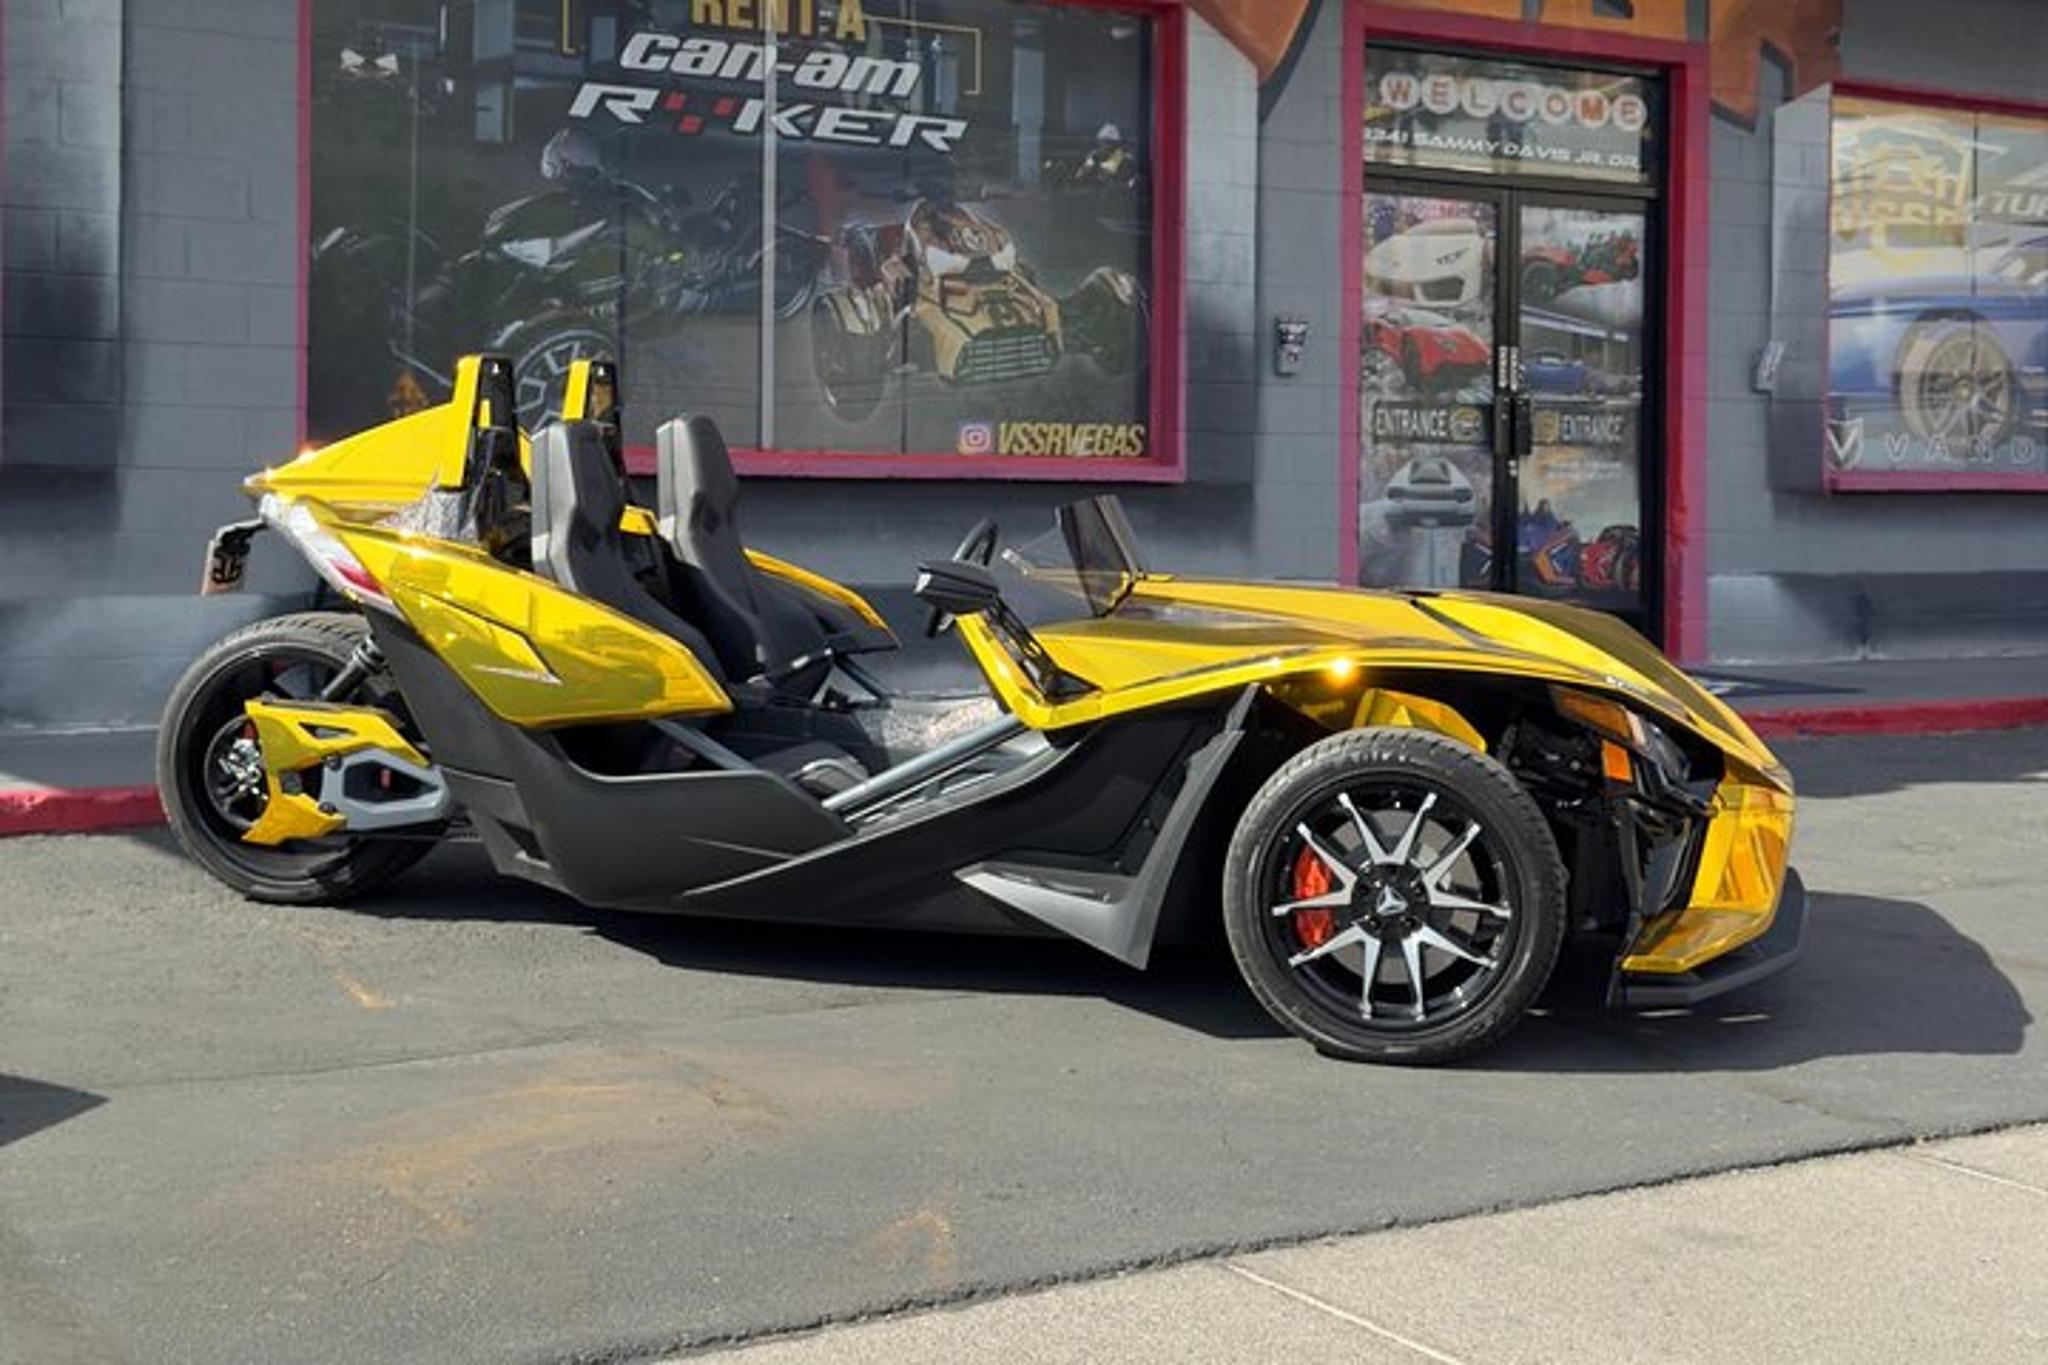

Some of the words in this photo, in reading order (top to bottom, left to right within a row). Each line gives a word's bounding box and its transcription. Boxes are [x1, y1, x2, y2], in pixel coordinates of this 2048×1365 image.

[620, 32, 921, 97] can-am
[1384, 77, 1641, 123] WELCOME
[1414, 132, 1499, 152] SAMMY
[1504, 141, 1571, 160] DAVIS
[999, 420, 1146, 457] VSSRVEGAS
[1376, 408, 1448, 438] ENTRANCE
[1562, 413, 1623, 444] ENTRANCE
